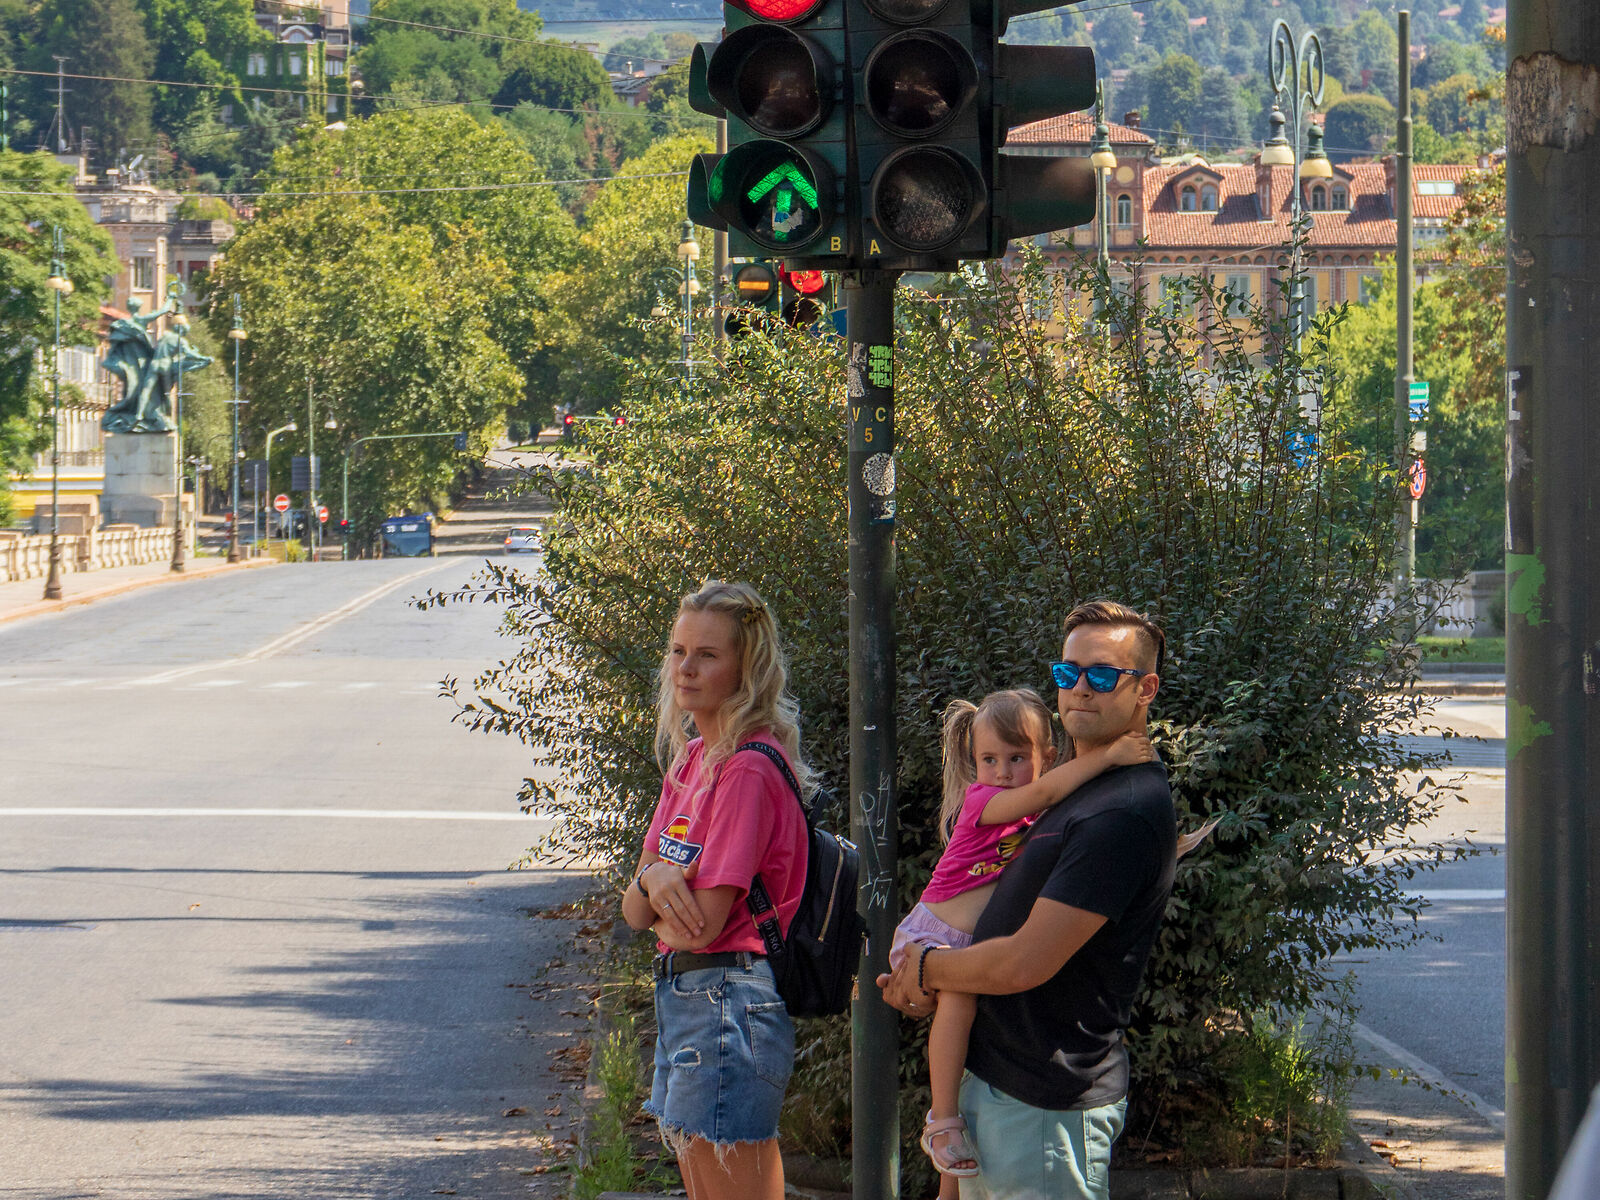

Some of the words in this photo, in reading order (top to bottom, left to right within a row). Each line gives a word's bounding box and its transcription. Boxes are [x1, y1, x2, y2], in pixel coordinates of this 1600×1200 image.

[830, 236, 841, 252] B
[870, 239, 881, 255] A
[864, 427, 873, 443] 5
